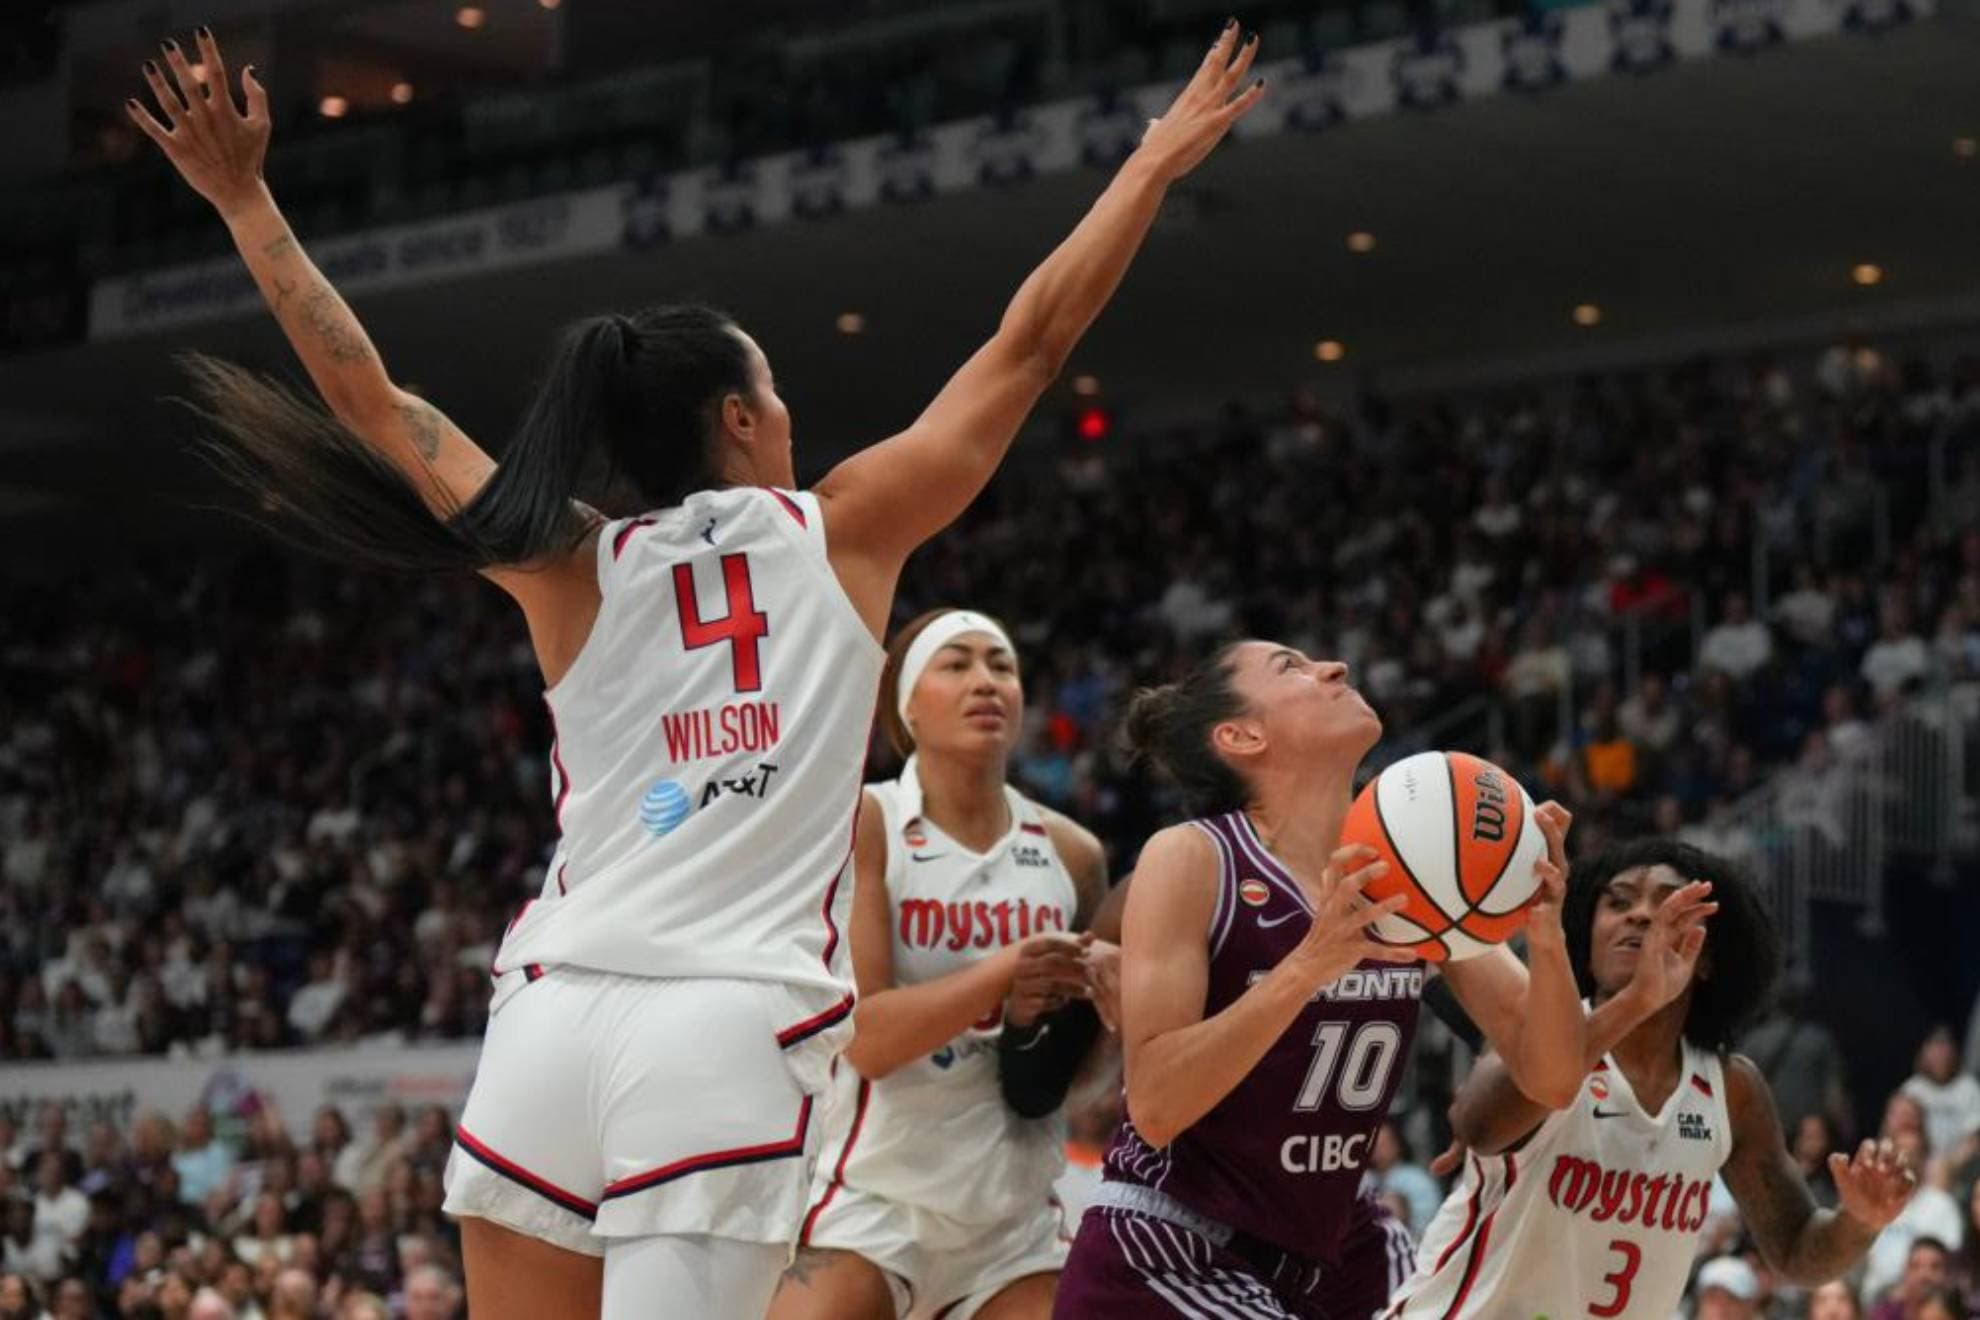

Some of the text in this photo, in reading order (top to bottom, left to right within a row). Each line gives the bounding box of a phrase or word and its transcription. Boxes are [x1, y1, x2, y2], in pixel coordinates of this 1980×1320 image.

[672, 551, 769, 693] 4
[661, 701, 780, 764] WILSON
[1474, 770, 1505, 841] Wil
[1246, 968, 1423, 1002] ONTO
[1293, 1020, 1401, 1112] 10
[1678, 1112, 1704, 1125] CAR
[1280, 1134, 1367, 1173] CIBC
[1587, 1239, 1642, 1319] 3
